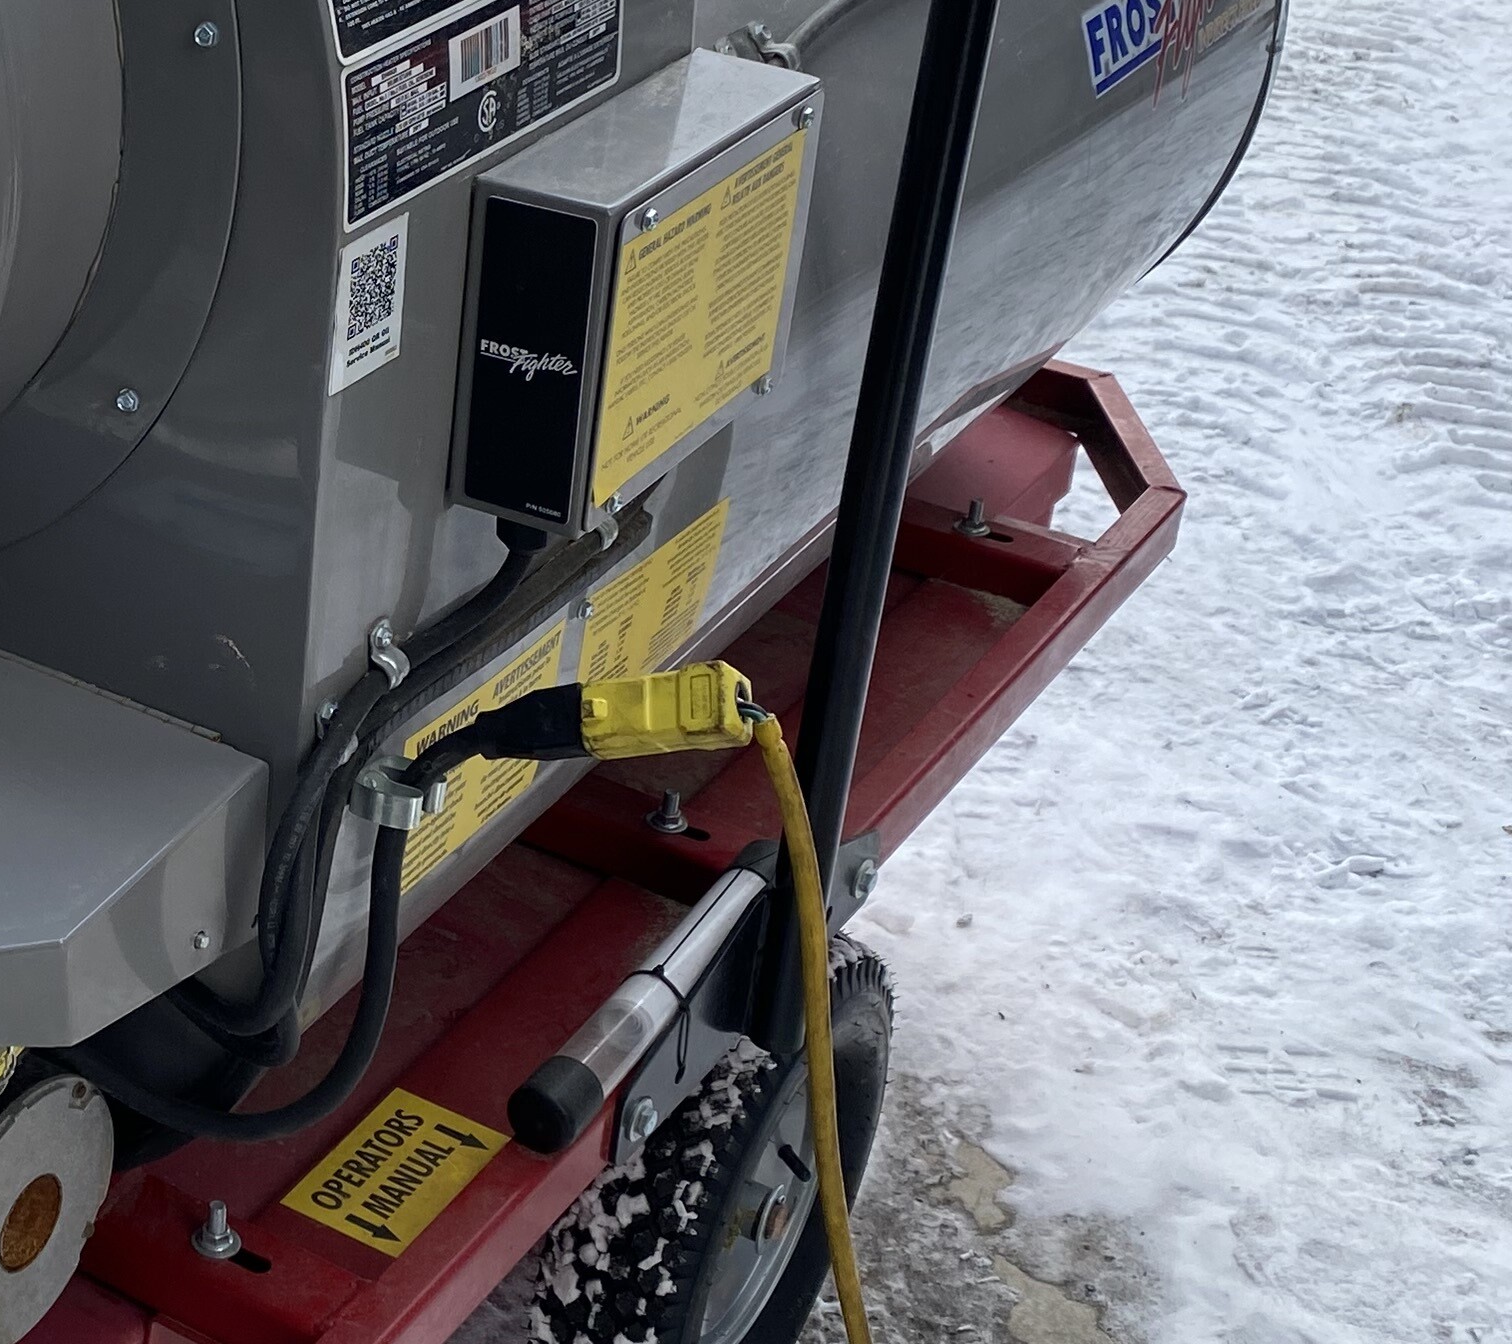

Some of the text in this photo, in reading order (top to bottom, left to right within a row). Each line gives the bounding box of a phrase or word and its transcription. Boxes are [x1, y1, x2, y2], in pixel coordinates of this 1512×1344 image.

[480, 339, 578, 381] FROST Fighter
[491, 629, 562, 700] AVERTISSEMENT
[415, 698, 479, 756] WARNING
[310, 1108, 425, 1211] OPERATORS
[360, 1139, 456, 1221] MANUAL
